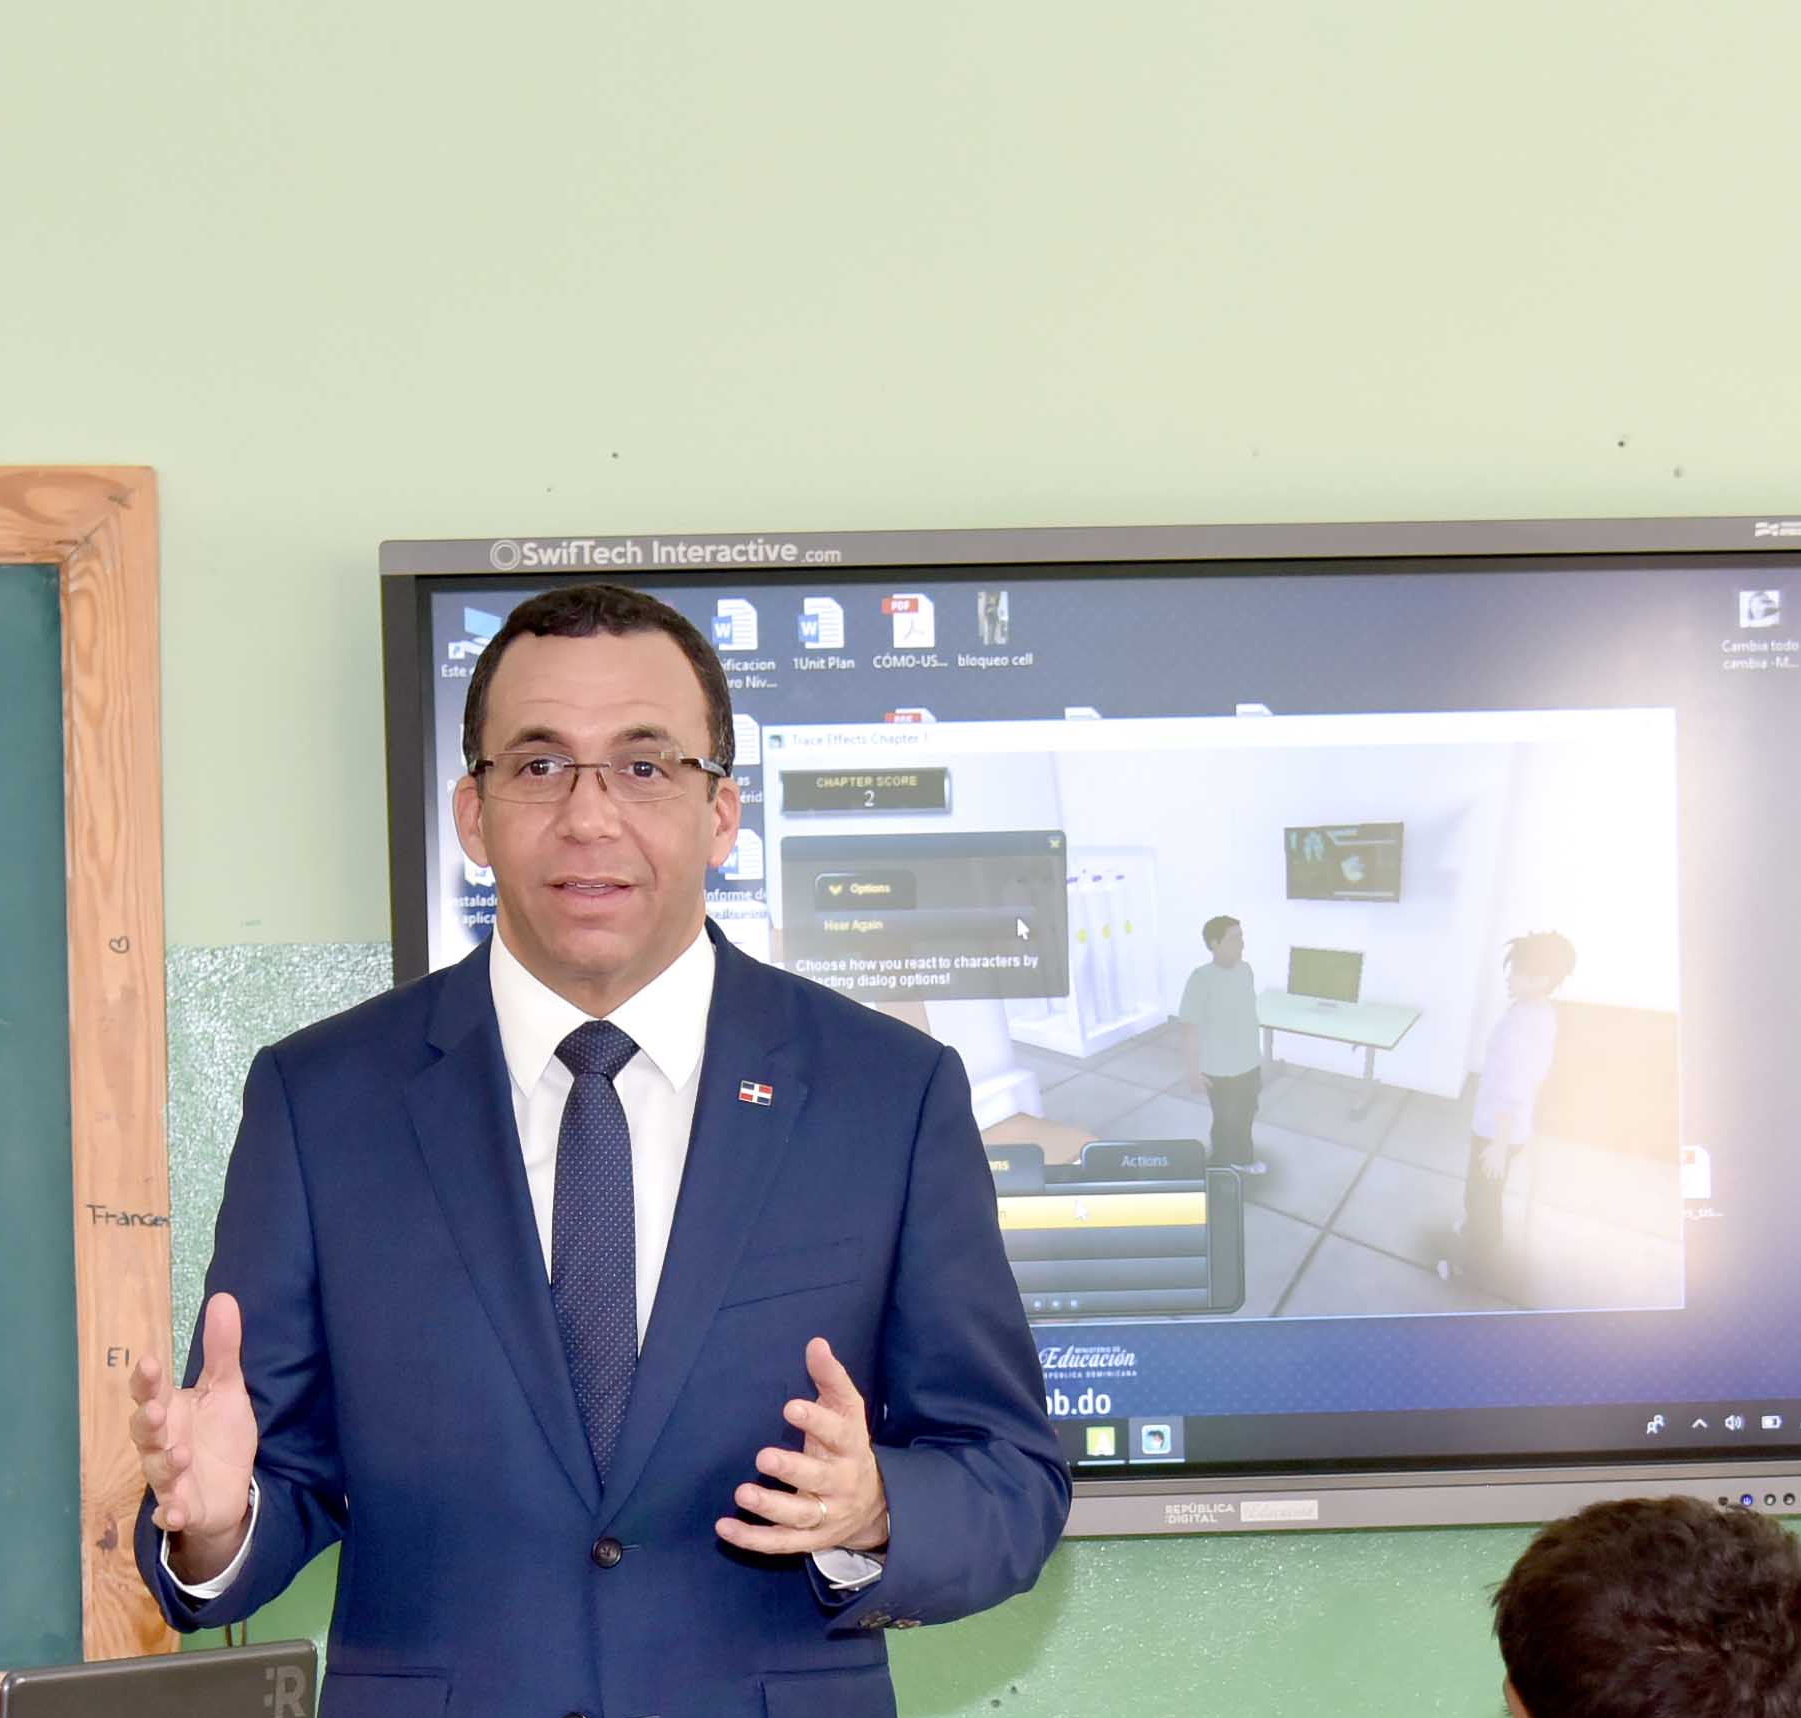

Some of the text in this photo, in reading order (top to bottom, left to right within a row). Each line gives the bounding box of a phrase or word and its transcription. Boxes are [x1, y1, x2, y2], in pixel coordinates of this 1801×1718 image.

[522, 538, 842, 565] SwifTech Interactive .com
[827, 655, 856, 669] Plan
[957, 652, 1034, 670] bloqueo cell
[827, 732, 867, 746] Effects
[815, 775, 919, 788] CHAPTER SCORE
[863, 789, 876, 807] 2
[795, 955, 1039, 974] Choose how you react to characters by
[857, 973, 897, 989] dialog
[899, 972, 951, 988] options!
[1121, 1154, 1168, 1168] Actions
[1038, 1345, 1136, 1369] Educación
